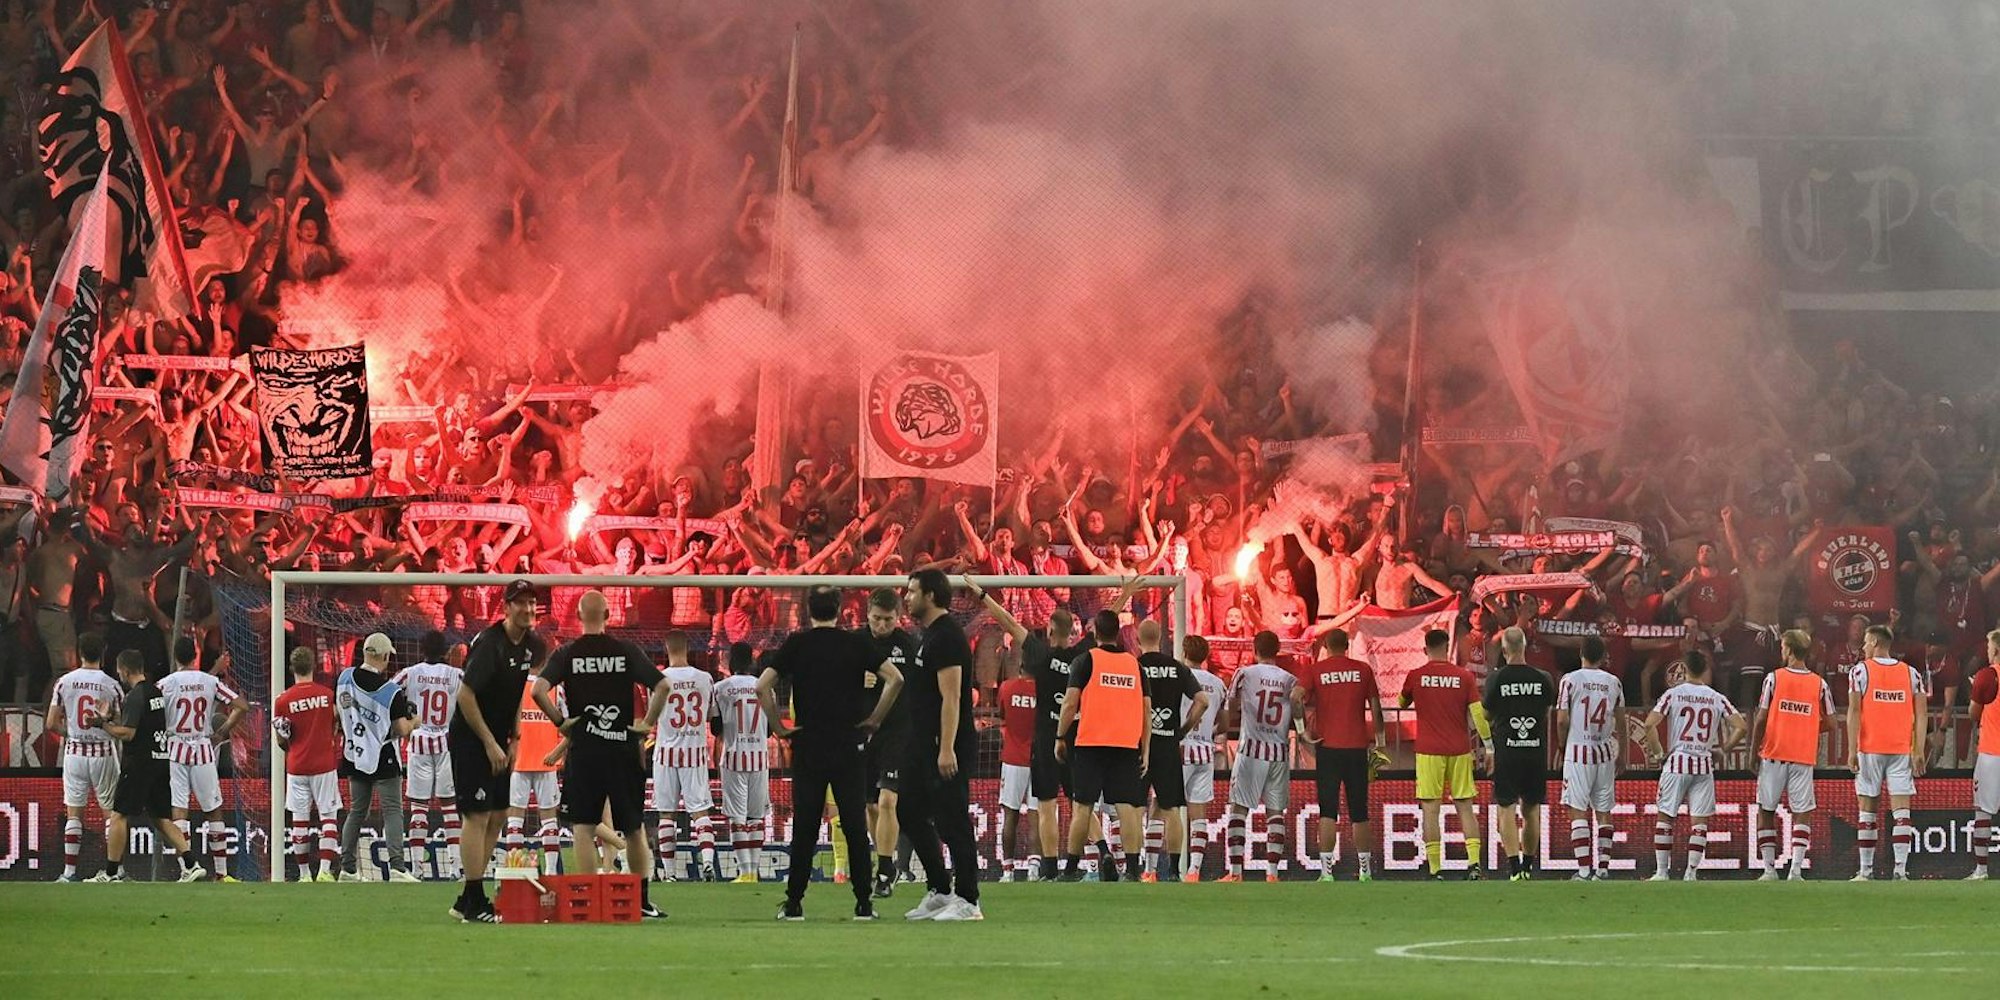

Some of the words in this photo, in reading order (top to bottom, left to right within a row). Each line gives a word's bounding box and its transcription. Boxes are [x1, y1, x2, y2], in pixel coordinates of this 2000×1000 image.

[256, 352, 307, 372] WILDE
[308, 349, 363, 369] HORDE
[933, 361, 984, 436] HORDE
[899, 447, 957, 466] 1996
[1554, 531, 1614, 548] KÖLN
[1817, 534, 1890, 570] SAUERLAND
[571, 656, 627, 674] REWE
[72, 682, 104, 692] MARTEL
[673, 681, 697, 690] DIETZ
[1102, 676, 1134, 688] REWE
[1259, 678, 1286, 688] KILIAN
[1320, 671, 1361, 685] REWE
[1421, 675, 1461, 689] REWE
[1583, 682, 1609, 692] HECTOR
[727, 687, 755, 696] SCHIND
[1500, 683, 1542, 697] REWE
[1875, 691, 1904, 701] REWE
[77, 695, 95, 731] 6
[289, 695, 329, 714] REWE
[419, 689, 449, 726] 19
[668, 691, 703, 729] 33
[1255, 689, 1283, 726] 15
[1780, 701, 1811, 714] REWE
[176, 696, 208, 734] 28
[733, 698, 762, 734] 17
[1581, 695, 1608, 733] 14
[586, 721, 627, 741] hummel
[1679, 706, 1713, 743] 29
[1506, 737, 1540, 748] hummel
